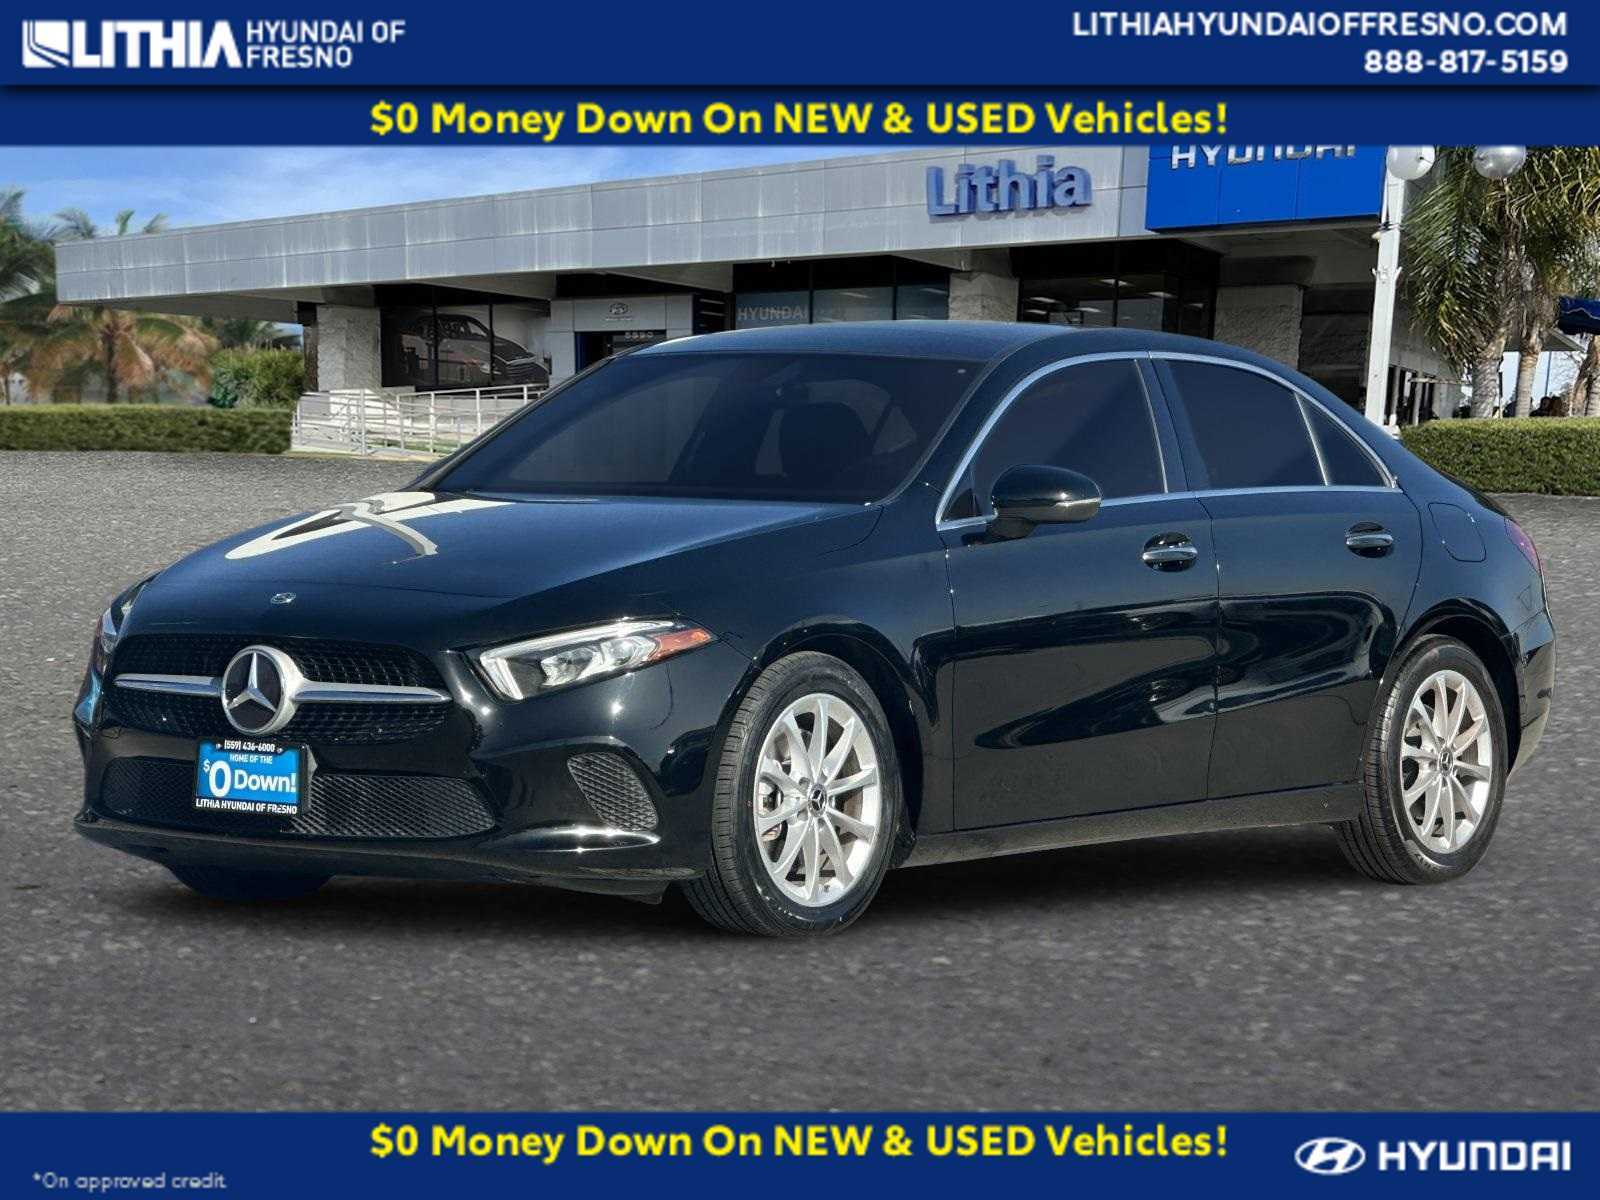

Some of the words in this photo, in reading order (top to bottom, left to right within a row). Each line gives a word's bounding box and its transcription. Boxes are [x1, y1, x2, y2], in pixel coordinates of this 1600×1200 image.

[926, 155, 1092, 217] Lithia
[737, 304, 809, 321] HYUNDAI
[230, 754, 248, 763] HOME
[249, 755, 258, 763] OF
[259, 755, 272, 764] THE
[233, 769, 297, 792] Down!
[195, 799, 220, 809] LITHIA
[221, 801, 254, 812] HYUNDAI
[255, 802, 265, 812] OF
[267, 803, 297, 815] FRESNO
